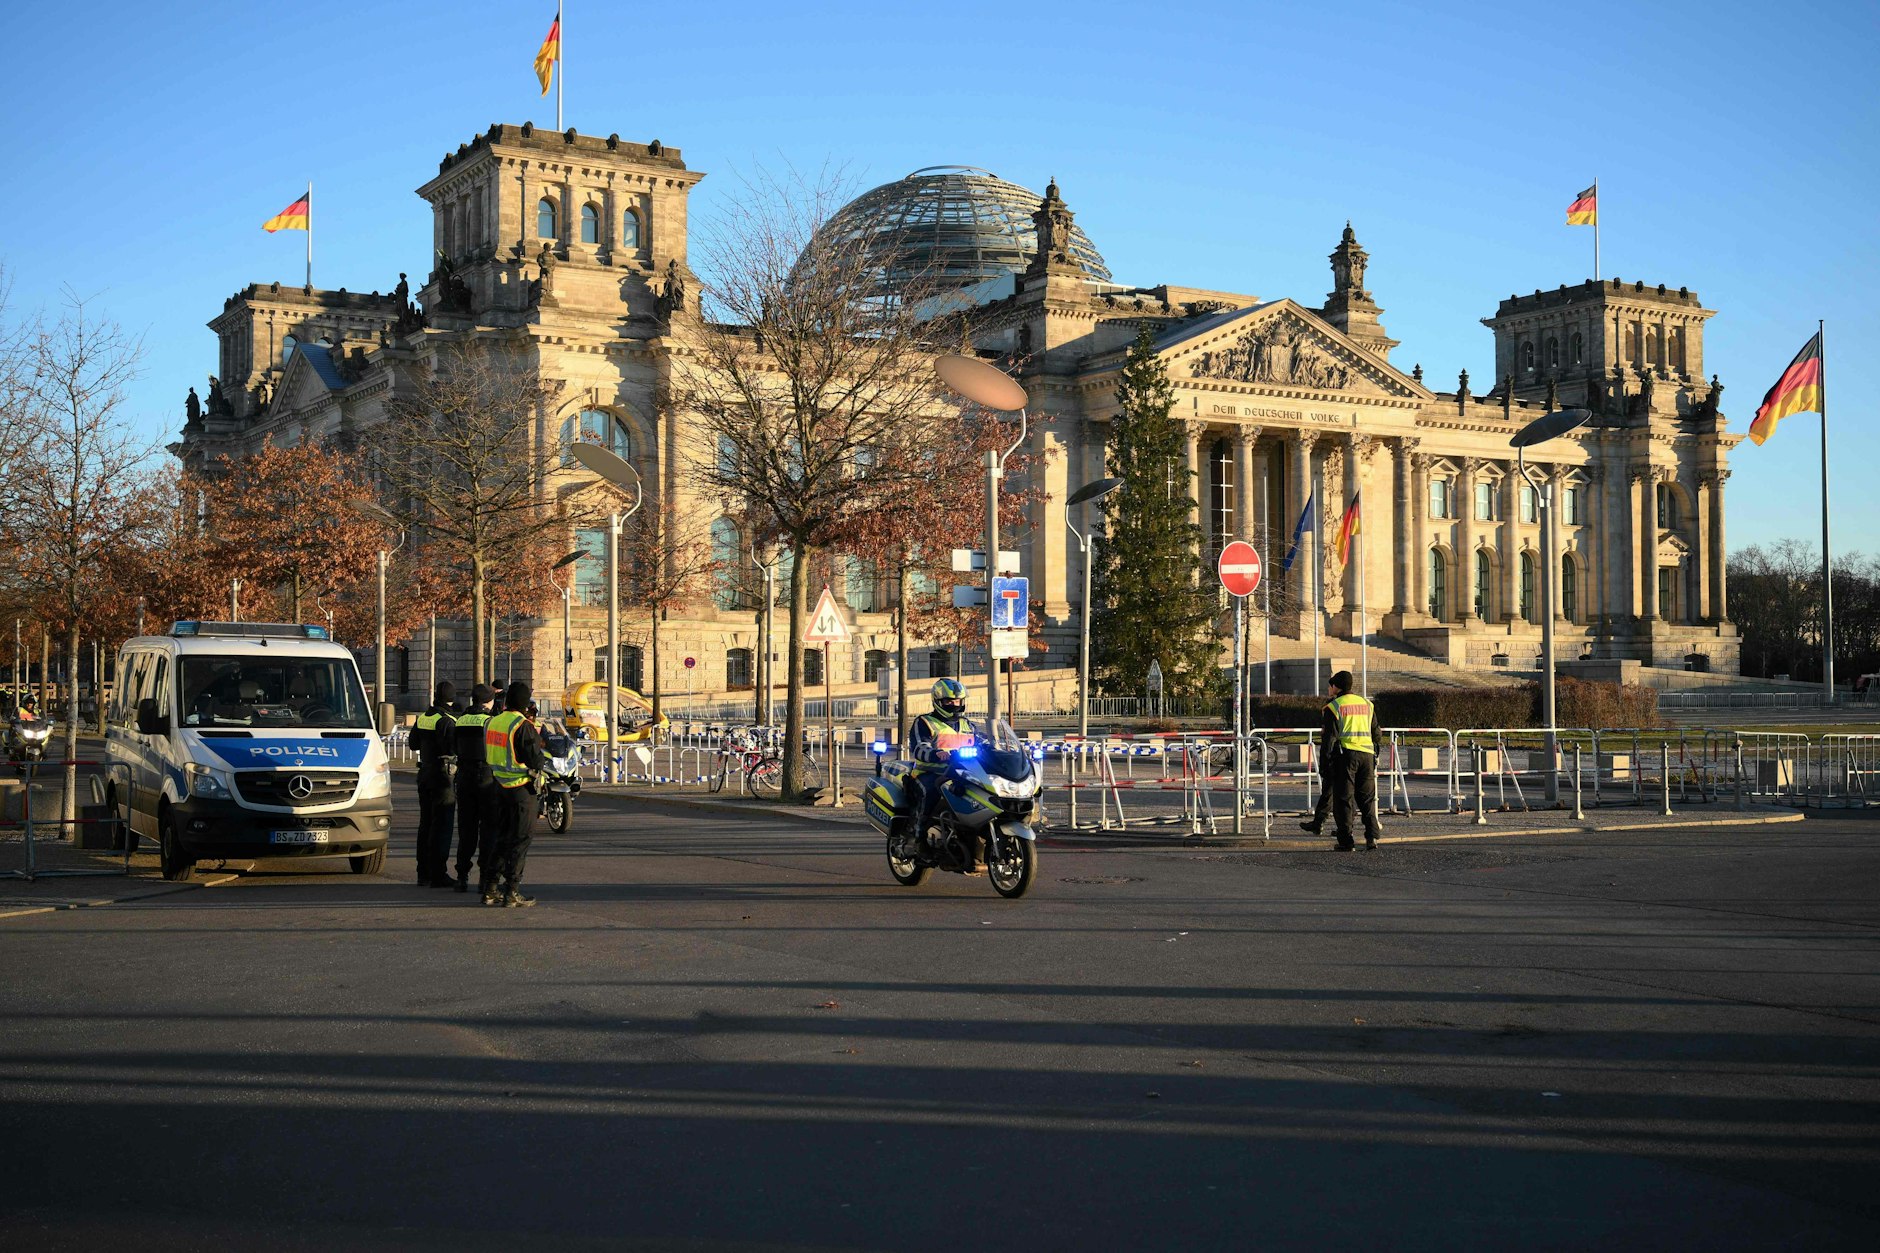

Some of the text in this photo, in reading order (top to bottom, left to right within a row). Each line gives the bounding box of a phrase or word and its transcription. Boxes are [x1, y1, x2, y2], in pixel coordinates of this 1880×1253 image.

[1213, 404, 1340, 423] DEM DEUTSCHEN VOLKE
[249, 746, 339, 758] POLIZEI
[867, 801, 889, 825] POLIZEI
[276, 832, 328, 842] BS ZD 7323
